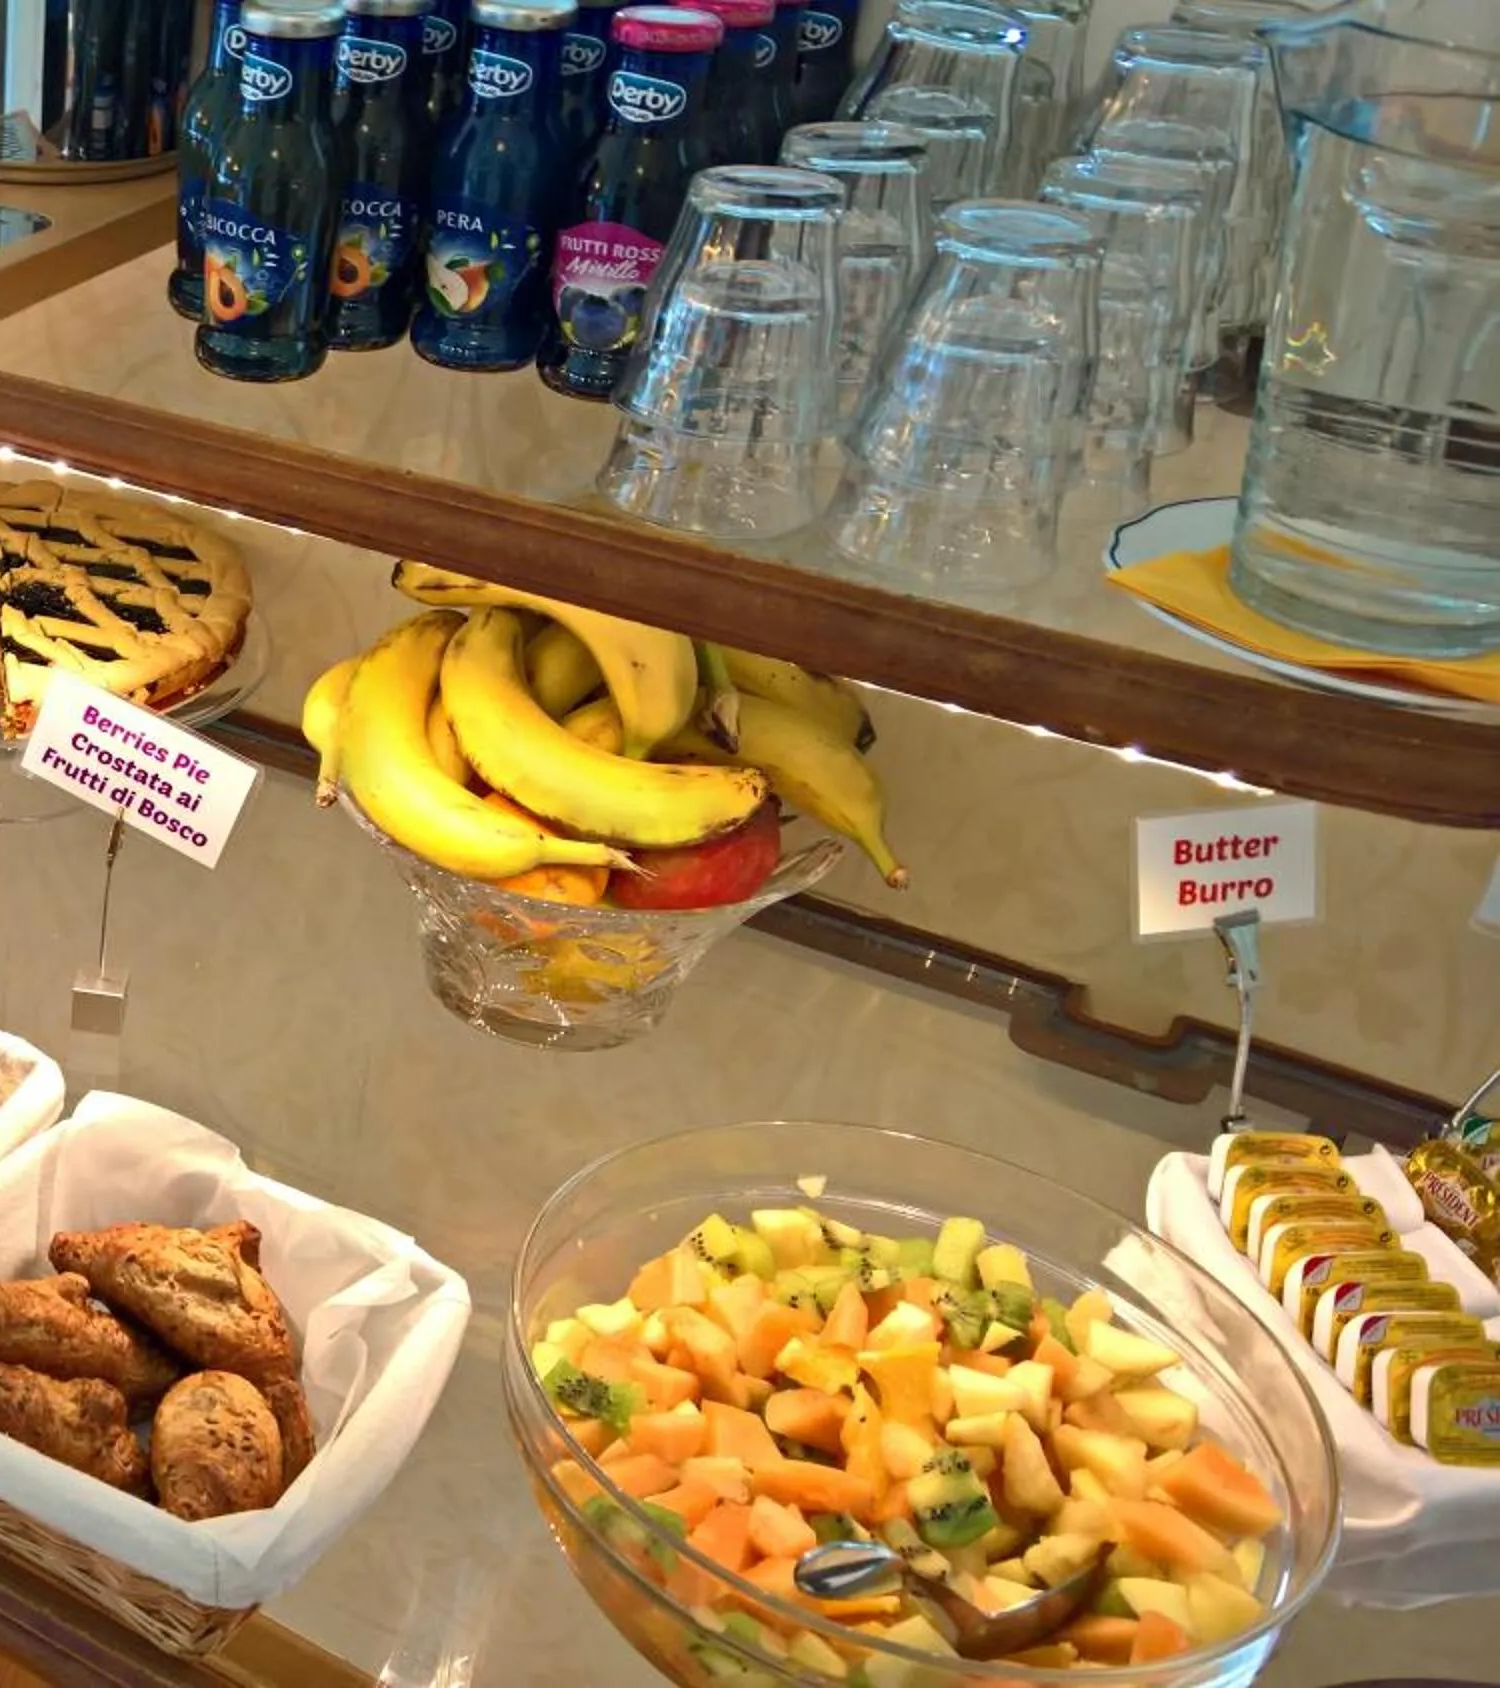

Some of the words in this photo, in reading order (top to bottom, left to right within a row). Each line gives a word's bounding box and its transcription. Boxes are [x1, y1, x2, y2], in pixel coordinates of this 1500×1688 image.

[339, 42, 402, 73] Derby
[242, 65, 286, 94] erby
[469, 61, 526, 91] erby
[612, 77, 681, 114] Derby
[205, 215, 277, 246] BICOCCA
[436, 208, 484, 233] PERA
[560, 234, 609, 256] FRUTTI
[612, 248, 661, 262] ROSS
[82, 704, 169, 764] Berries
[172, 752, 211, 785] Pie
[71, 732, 174, 799] Crostata
[176, 791, 202, 812] ai
[41, 747, 109, 794] Frutti
[110, 787, 137, 809] di
[137, 798, 208, 848] Bosco
[1174, 834, 1280, 865] Butter
[1178, 877, 1274, 906] Burro
